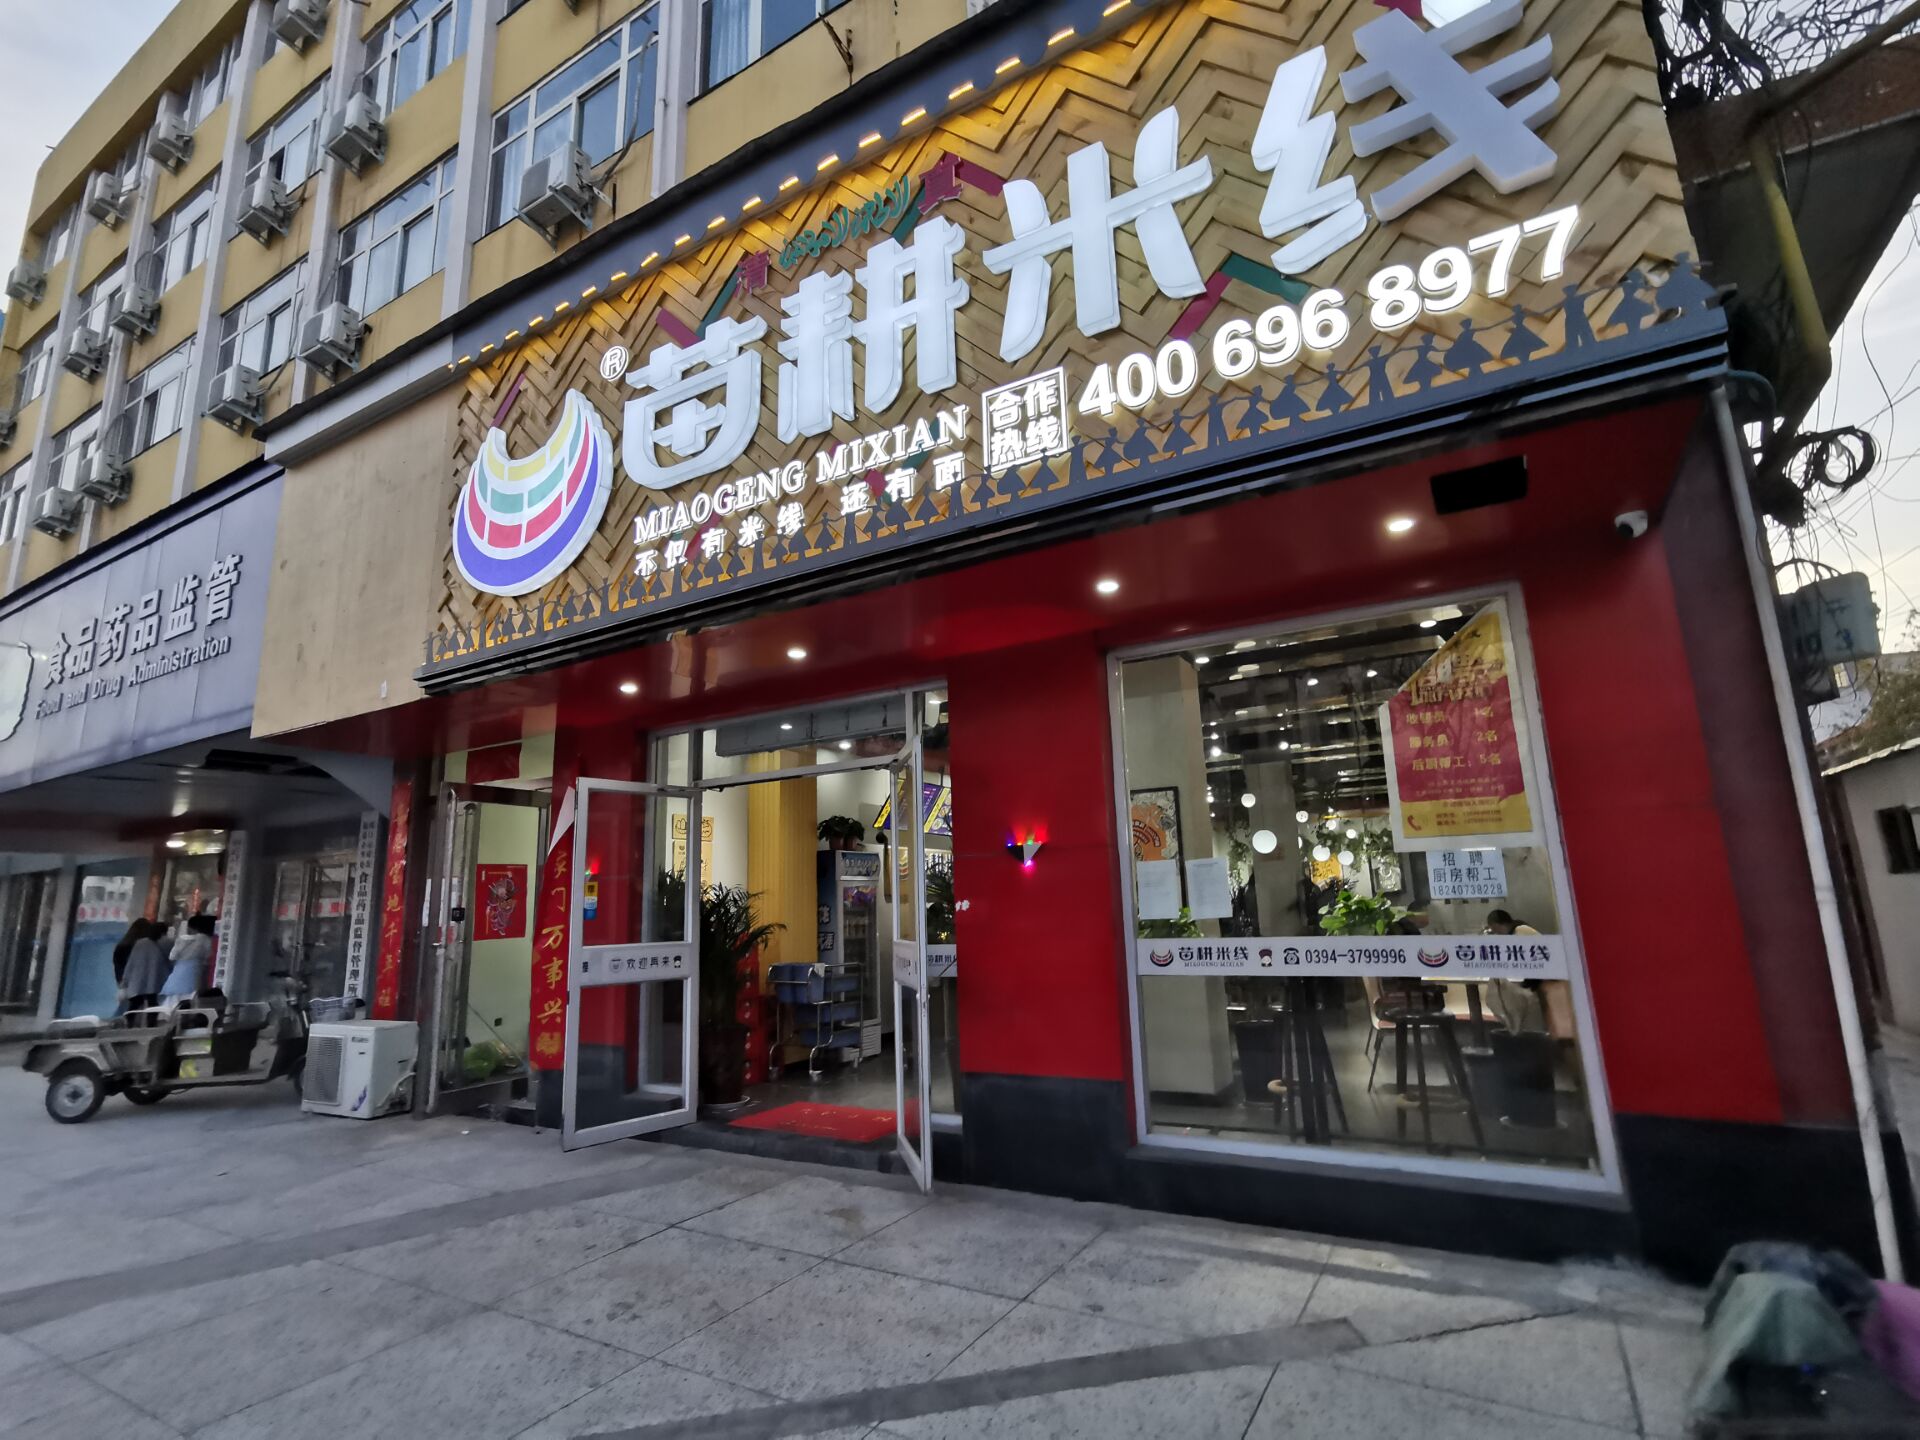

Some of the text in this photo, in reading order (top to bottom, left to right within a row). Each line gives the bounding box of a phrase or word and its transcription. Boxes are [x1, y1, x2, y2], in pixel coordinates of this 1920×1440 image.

[621, 0, 1560, 489] 苗耕米线
[1078, 204, 1580, 418] 400 696 8977
[989, 378, 1059, 431] 合作
[990, 414, 1062, 467] 热线
[633, 404, 969, 546] MIAOGENG MIXIAN
[44, 553, 243, 690] 食品药品监管
[91, 675, 124, 700] Drug
[128, 635, 232, 688] Administration
[1433, 866, 1498, 884] 厨房帮工
[1178, 946, 1249, 962] 苗耕米线
[1454, 944, 1551, 963] 苗耕米线
